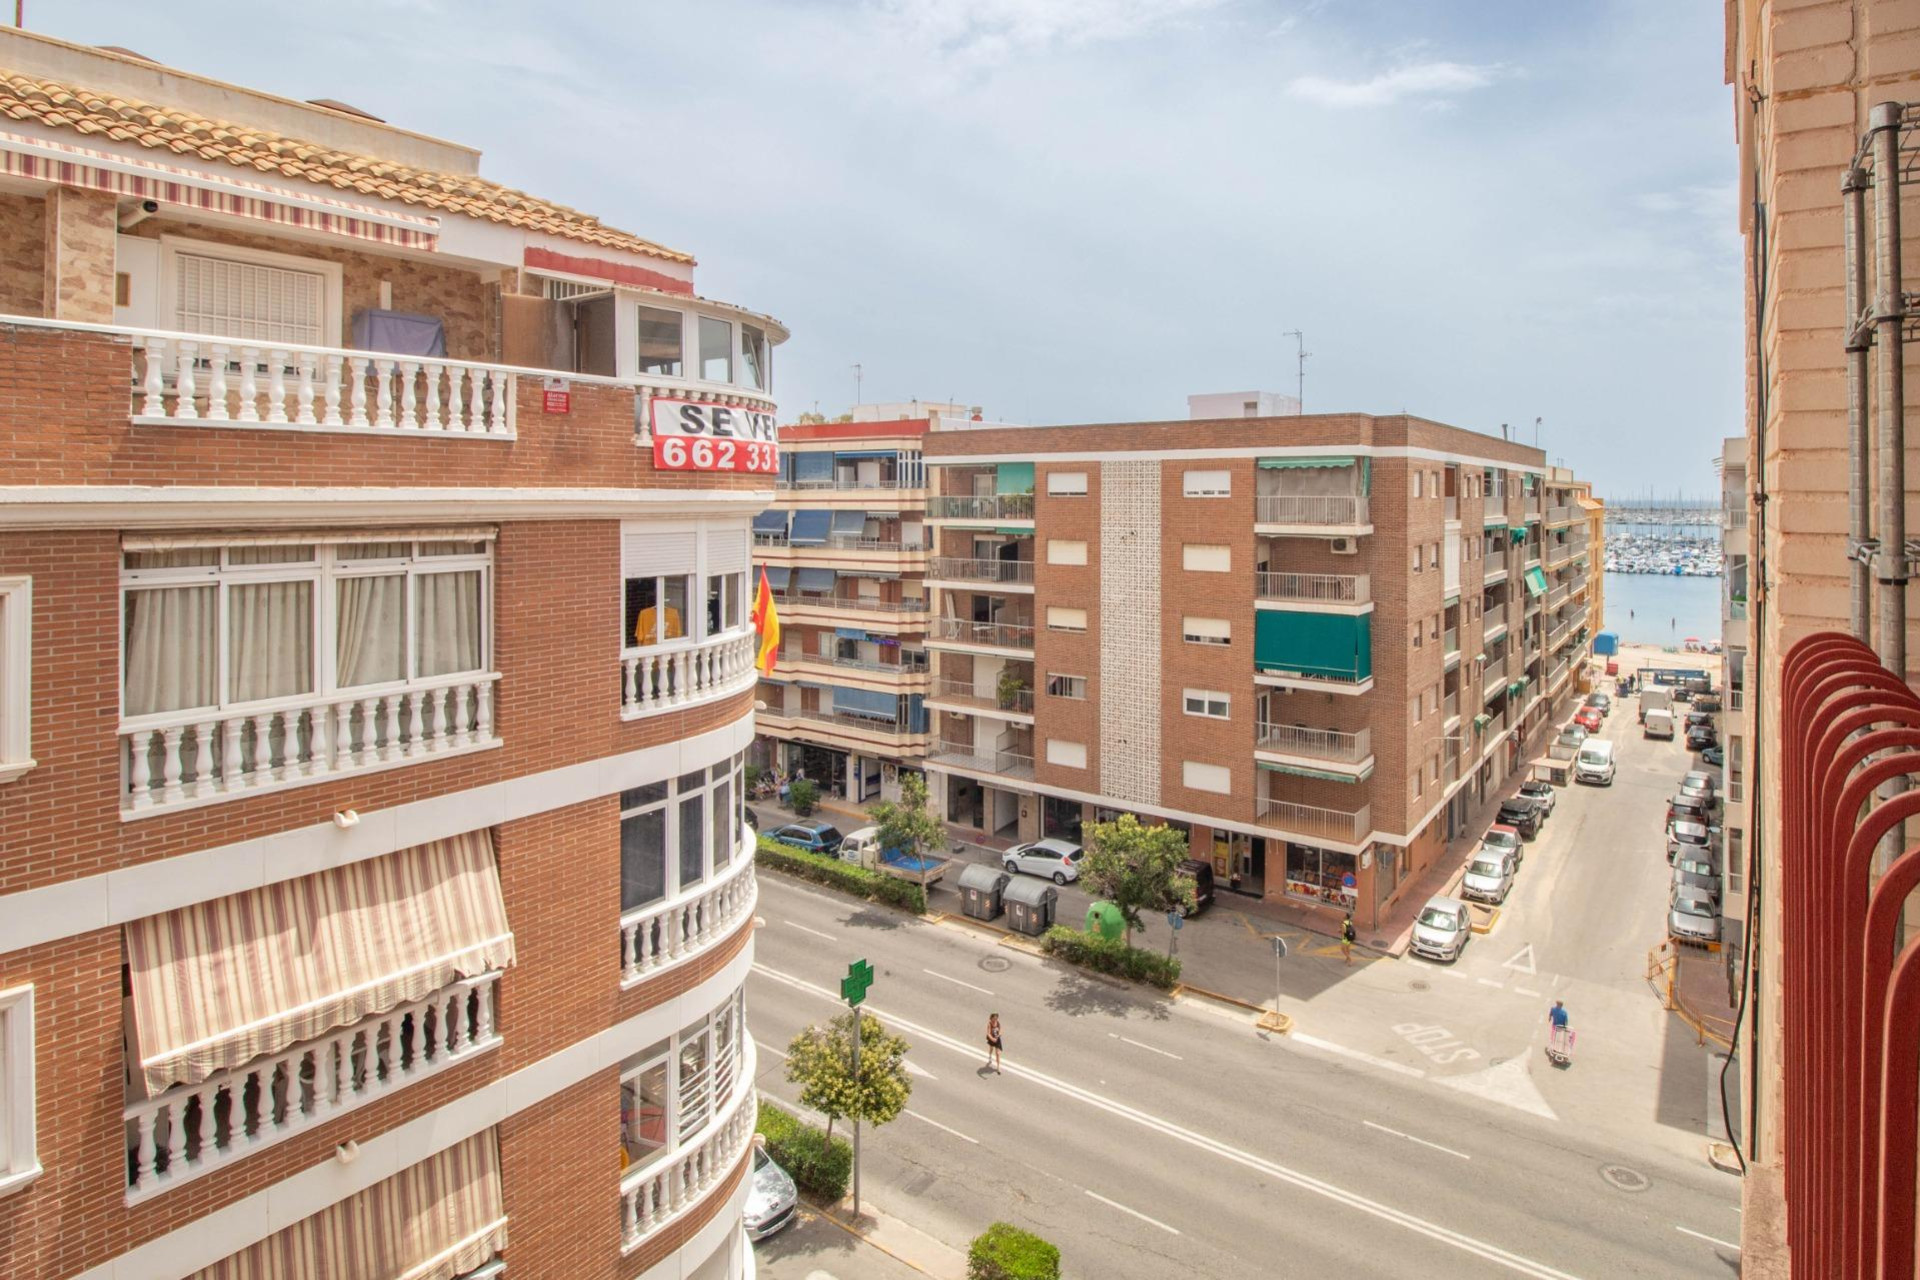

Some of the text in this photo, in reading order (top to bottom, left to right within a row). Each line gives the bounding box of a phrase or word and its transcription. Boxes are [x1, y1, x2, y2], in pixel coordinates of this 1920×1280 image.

[680, 404, 733, 436] SE
[663, 438, 736, 468] 662
[1391, 1023, 1481, 1064] STOP
